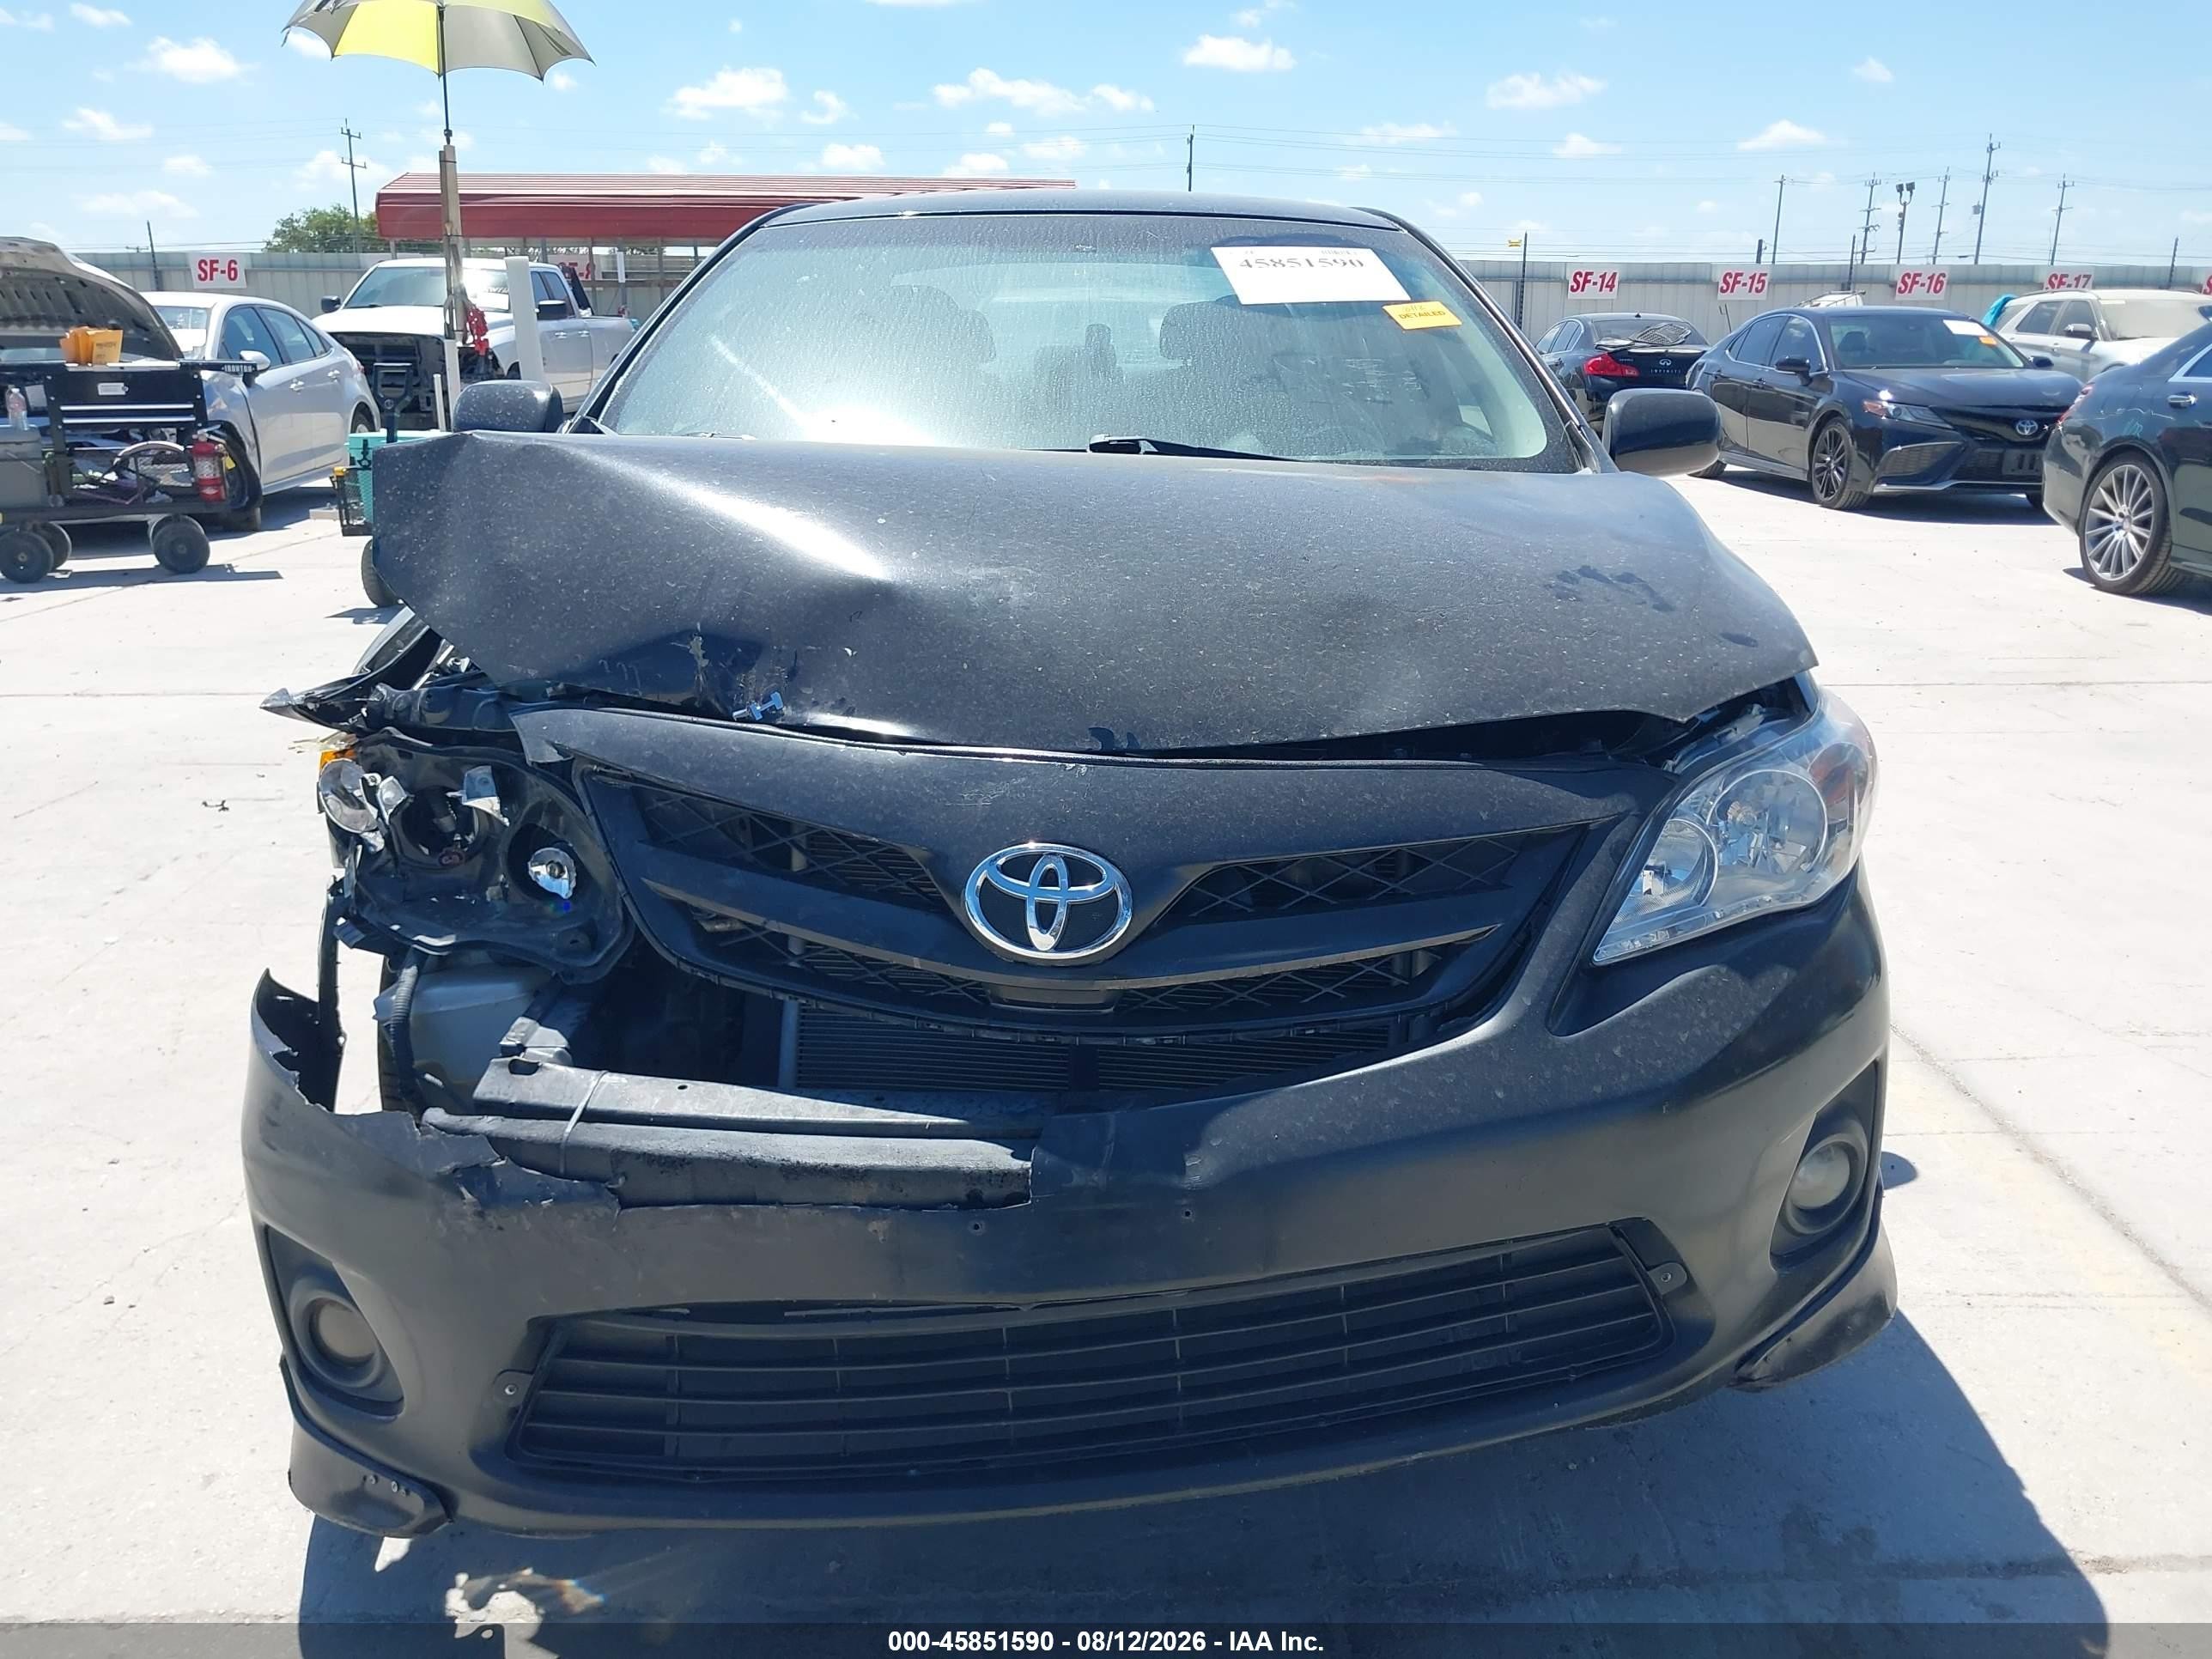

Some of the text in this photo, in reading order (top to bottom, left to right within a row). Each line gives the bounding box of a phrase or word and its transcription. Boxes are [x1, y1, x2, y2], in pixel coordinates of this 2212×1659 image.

[198, 258, 238, 282] SF-6
[1239, 258, 1364, 269] 45851590
[1570, 270, 1618, 293] SF-14
[1719, 271, 1767, 294] SF-15
[1898, 272, 1946, 294] SF-16
[2045, 273, 2092, 289] SF-17
